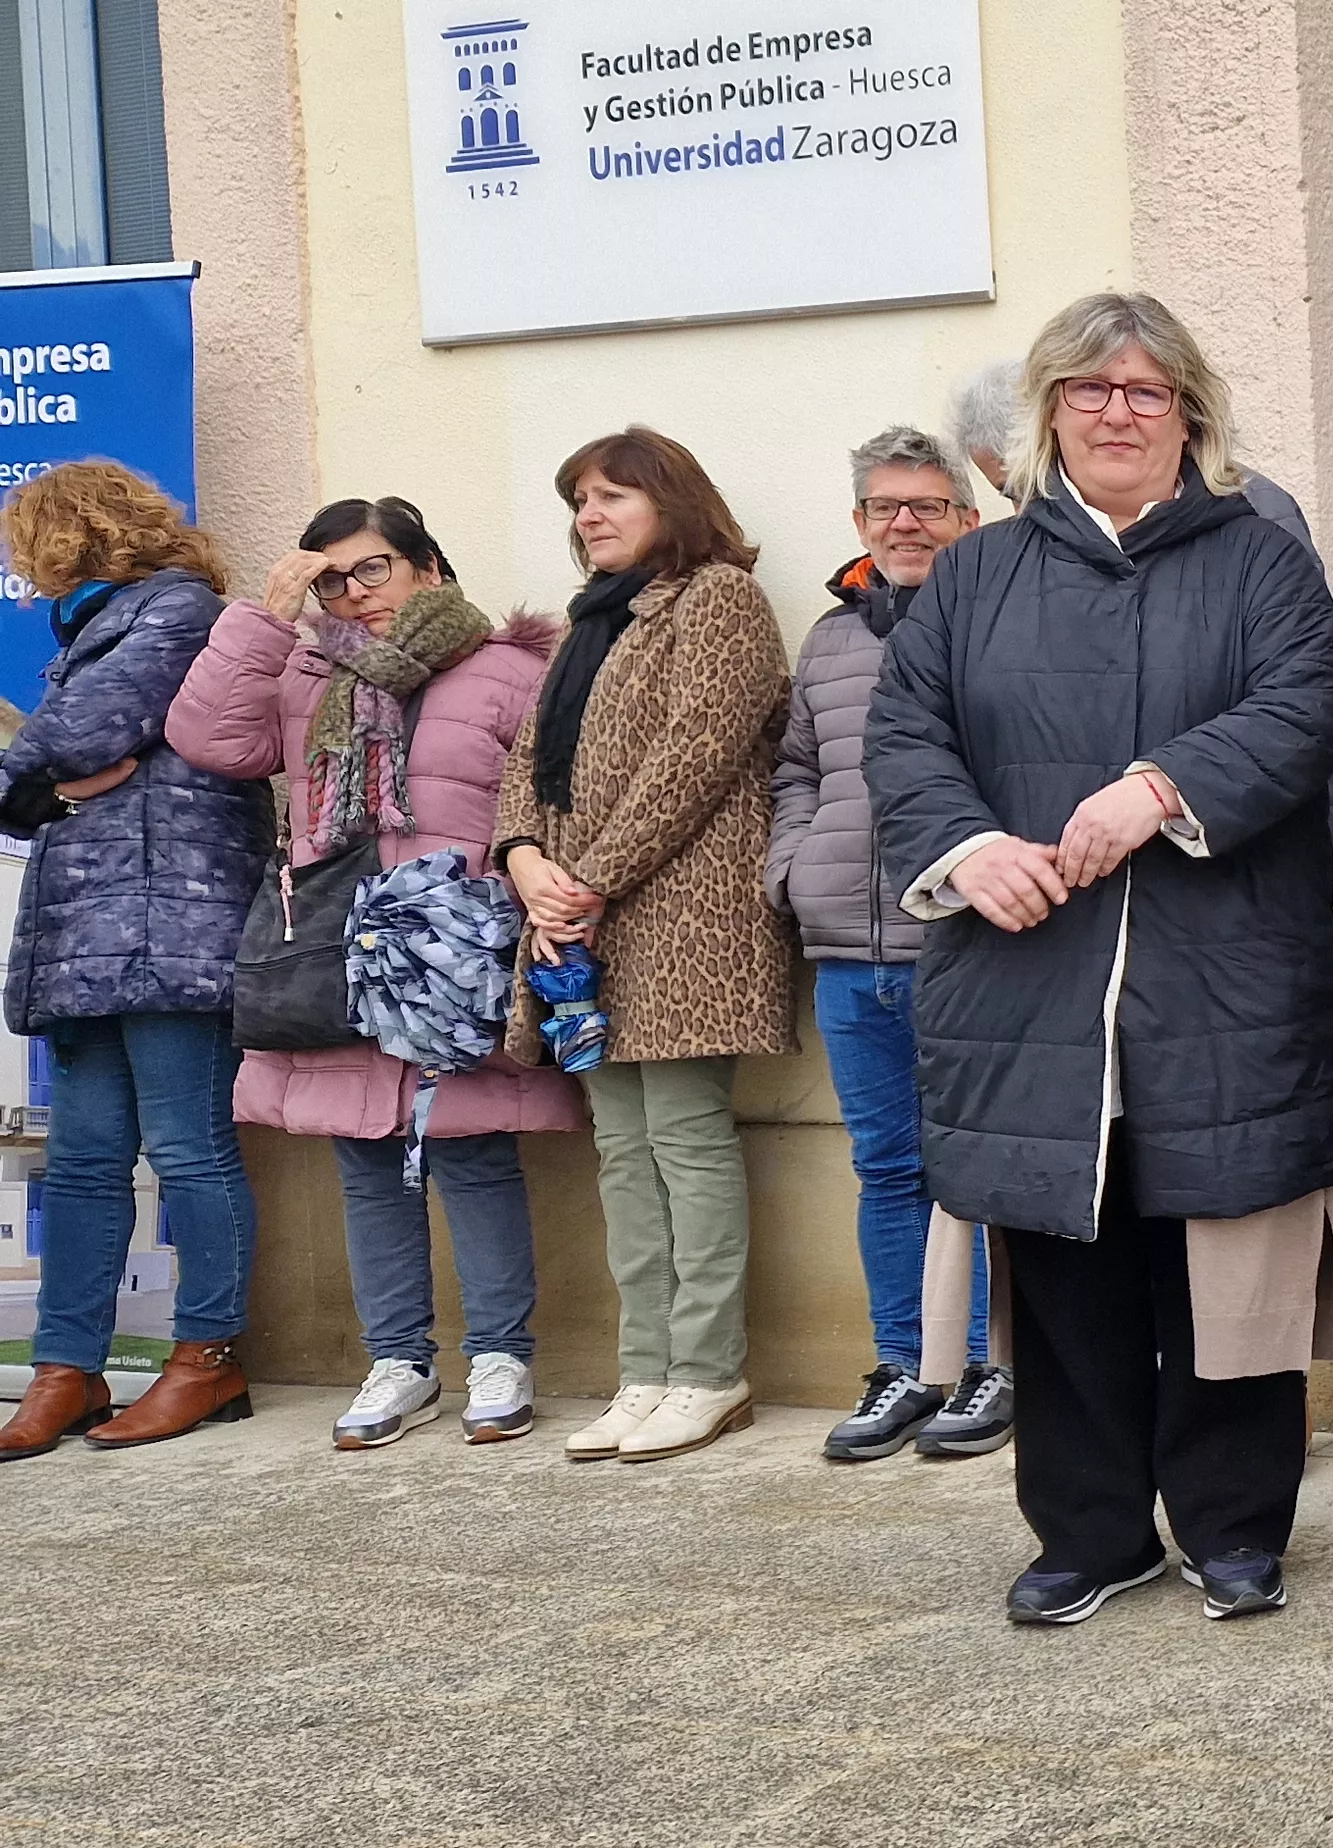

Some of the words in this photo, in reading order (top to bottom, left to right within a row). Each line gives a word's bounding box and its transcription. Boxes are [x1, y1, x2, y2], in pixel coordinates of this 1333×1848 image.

[581, 38, 700, 80] Facultad
[706, 35, 741, 65] de
[748, 26, 873, 63] Empresa
[583, 104, 599, 133] y
[604, 87, 713, 123] Gestión
[720, 74, 825, 111] Pública
[849, 65, 951, 96] Huesca
[588, 125, 785, 181] Universidad
[791, 119, 958, 162] Zaragoza
